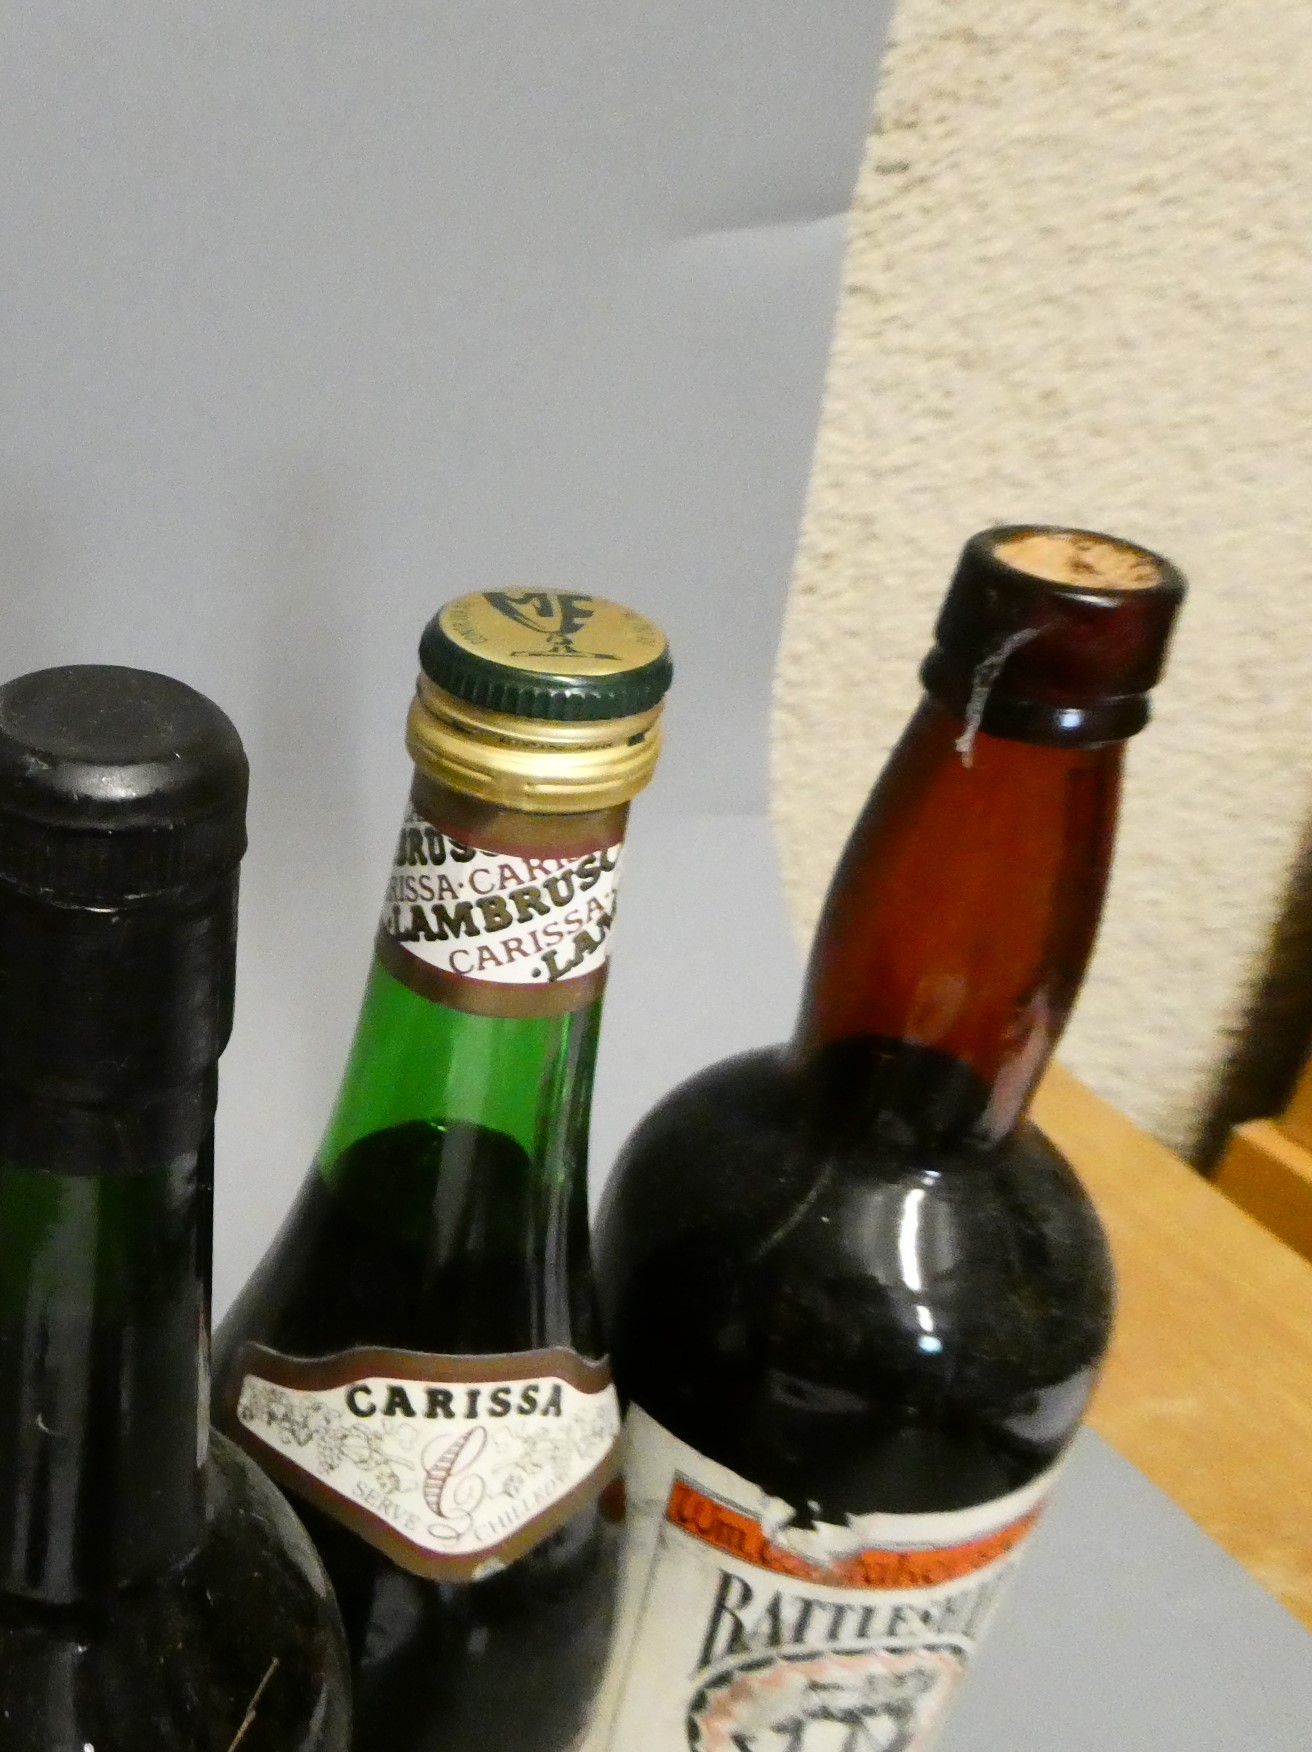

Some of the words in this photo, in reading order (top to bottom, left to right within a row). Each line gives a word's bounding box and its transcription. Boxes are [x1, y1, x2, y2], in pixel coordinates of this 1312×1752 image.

[395, 826, 499, 866] RUS
[468, 857, 579, 896] CAR
[448, 896, 605, 976] CARISSA
[345, 1383, 564, 1419] CARISSA
[353, 1482, 420, 1532] SERVE
